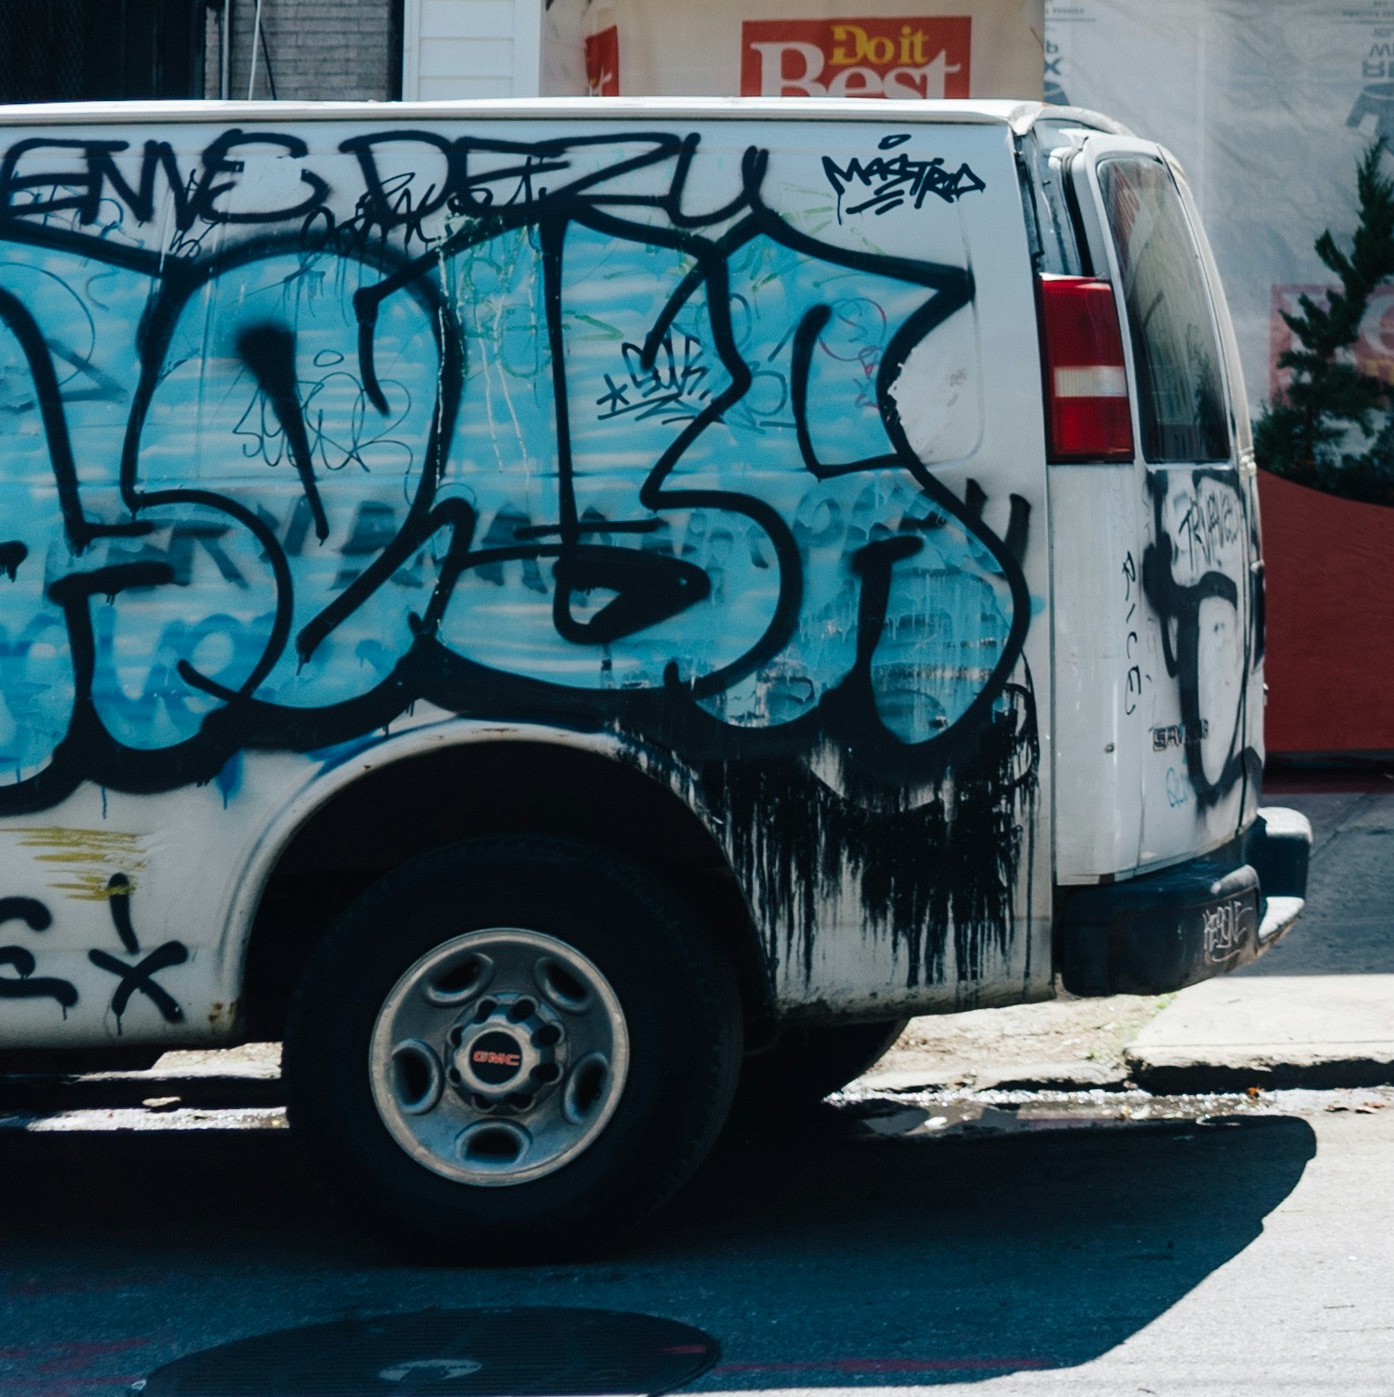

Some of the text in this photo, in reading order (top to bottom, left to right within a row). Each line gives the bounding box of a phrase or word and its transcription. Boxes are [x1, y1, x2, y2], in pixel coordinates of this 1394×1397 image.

[829, 25, 931, 66] Do it
[473, 1050, 521, 1067] GMC
